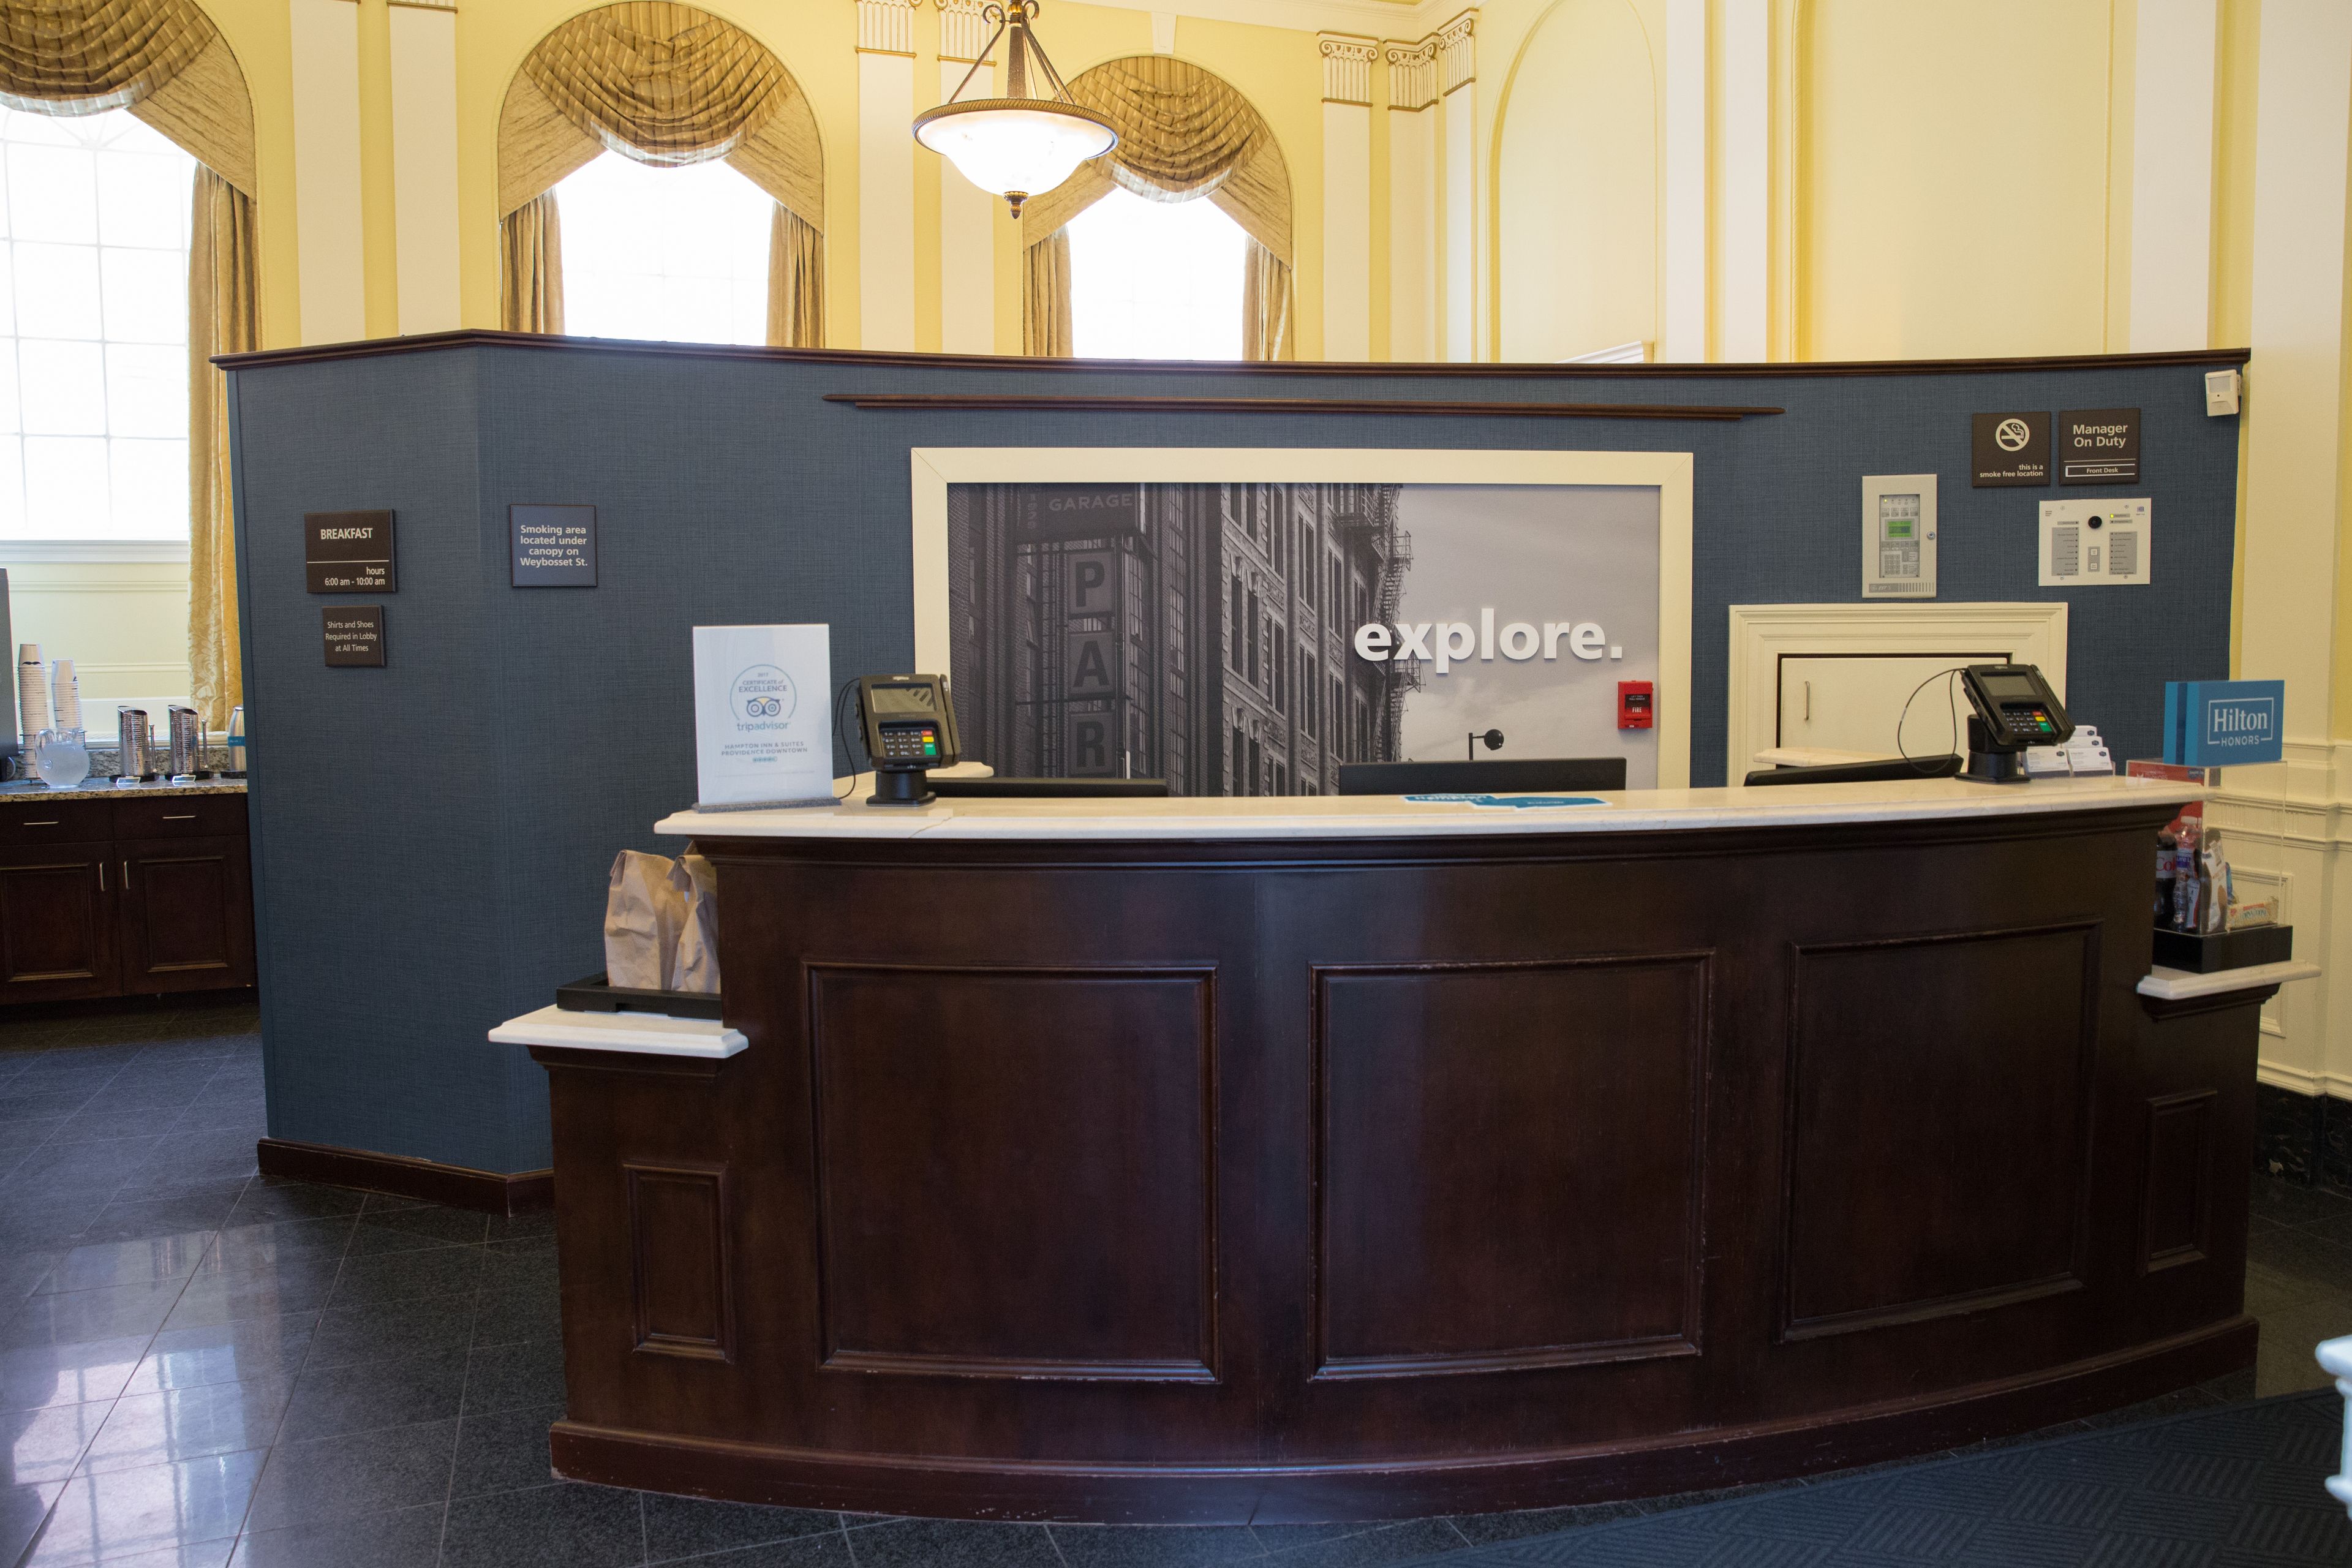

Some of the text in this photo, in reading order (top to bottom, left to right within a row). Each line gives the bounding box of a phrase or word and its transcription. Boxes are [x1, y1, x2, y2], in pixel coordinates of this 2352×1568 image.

[2073, 424, 2128, 436] Manager
[2074, 437, 2126, 448] On Duty
[1049, 494, 1133, 511] GARAGE
[320, 528, 373, 540] BREAKFAST
[521, 525, 562, 535] Smoking
[559, 536, 587, 545] under
[520, 557, 573, 568] Weybosset
[356, 577, 373, 586] 10:00
[325, 633, 351, 641] Required
[360, 632, 377, 641] Lobby
[1354, 608, 1623, 674] explore.
[2214, 708, 2267, 732] Hilton
[737, 722, 788, 733] tripadvisor
[2221, 735, 2260, 747] HONORS
